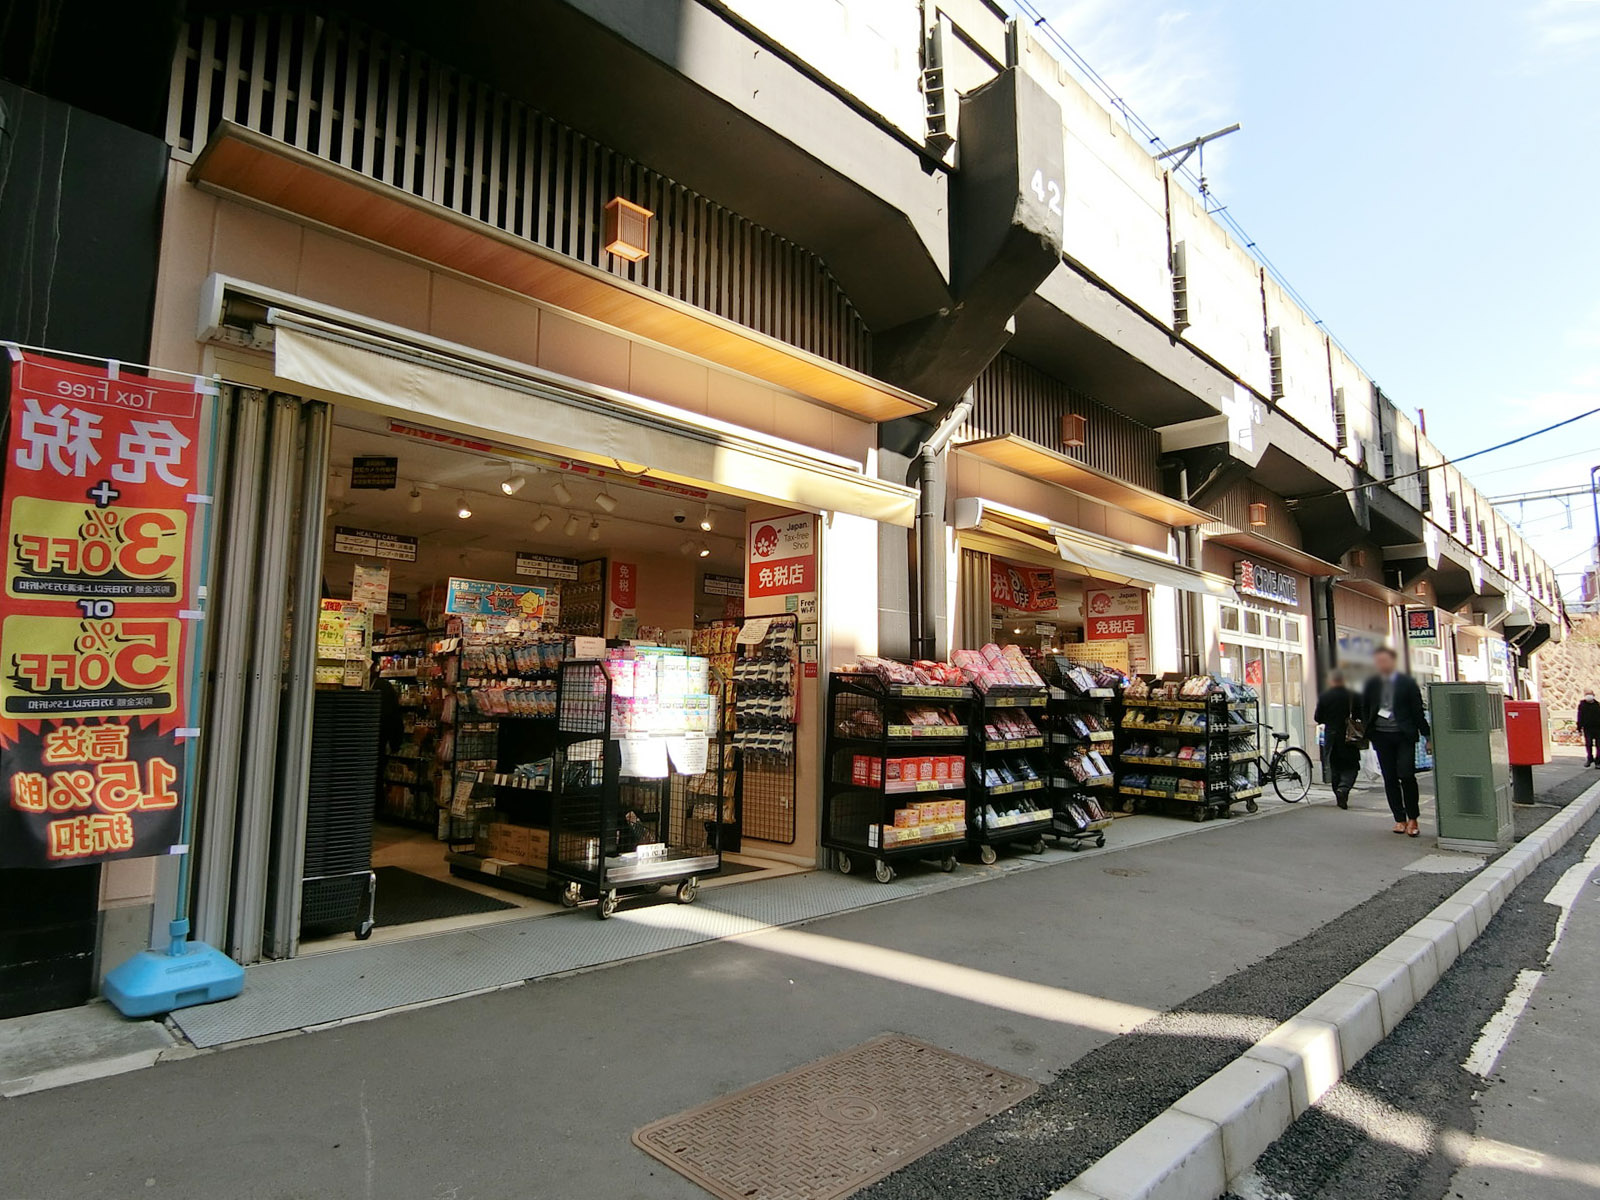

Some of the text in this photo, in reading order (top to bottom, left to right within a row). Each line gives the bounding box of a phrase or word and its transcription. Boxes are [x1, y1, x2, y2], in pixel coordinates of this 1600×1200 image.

[1030, 168, 1062, 215] 42
[356, 531, 381, 540] HEALTH
[784, 532, 810, 542] Tax-free
[792, 542, 810, 550] Shop
[758, 564, 804, 588] 免税店
[1241, 560, 1297, 601] 薬 CREATE
[800, 599, 816, 607] Free
[1012, 591, 1030, 609] OFF
[800, 606, 816, 615] Wi-Fi
[1409, 612, 1430, 630] 薬
[1096, 620, 1136, 635] 免税店
[1408, 629, 1435, 637] CREATE
